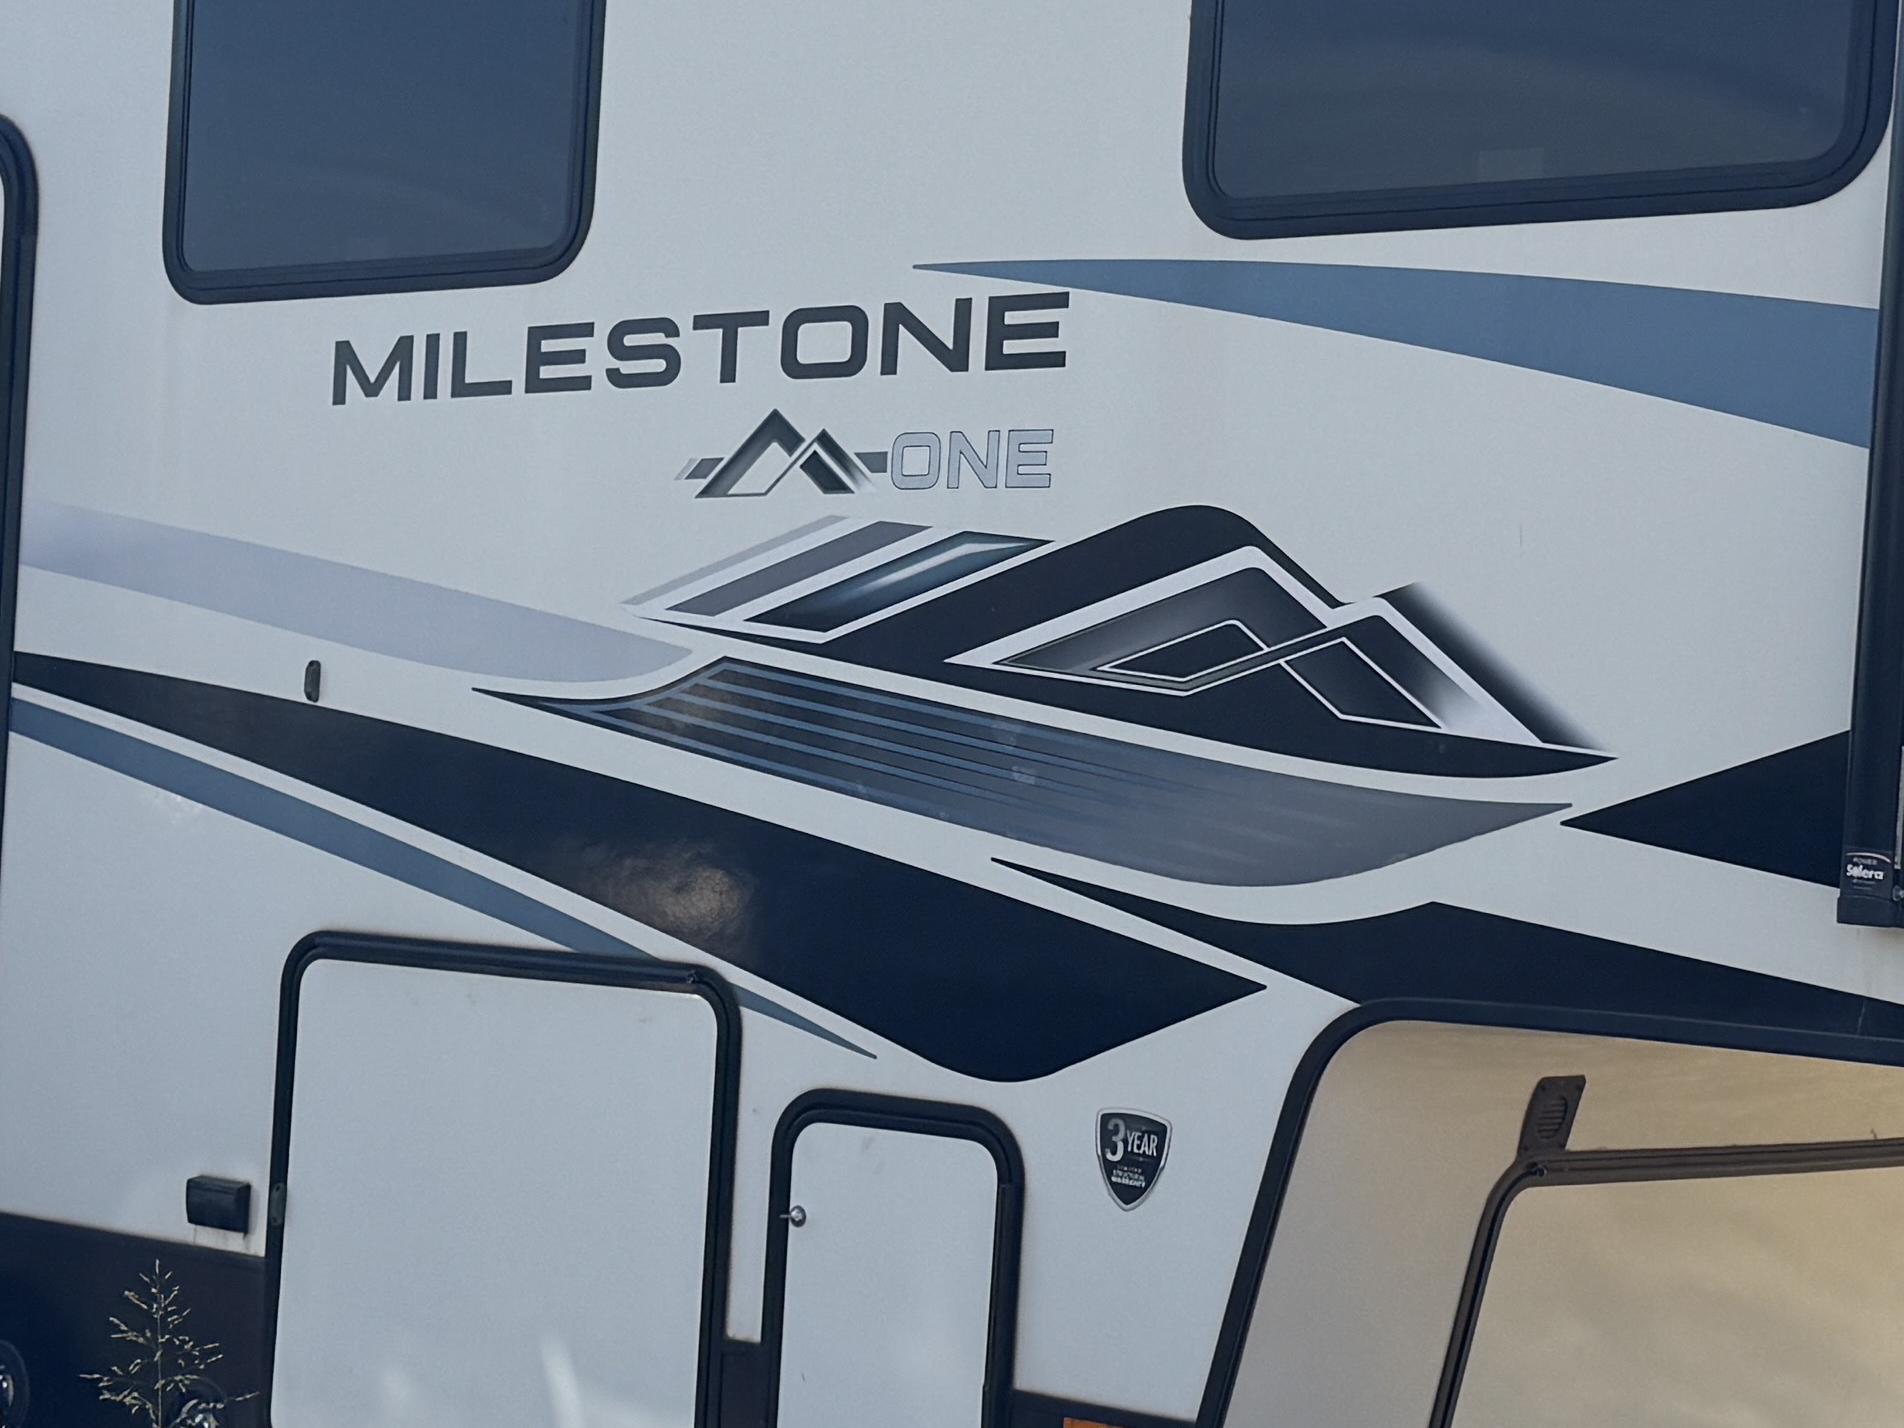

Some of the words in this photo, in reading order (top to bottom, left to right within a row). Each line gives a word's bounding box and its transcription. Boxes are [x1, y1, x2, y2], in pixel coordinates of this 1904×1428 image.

[331, 291, 1071, 406] MILESTONE
[890, 428, 1055, 491] ONE
[1846, 863, 1885, 881] Solera
[1105, 1118, 1126, 1162] 3
[1126, 1129, 1158, 1157] YEAR
